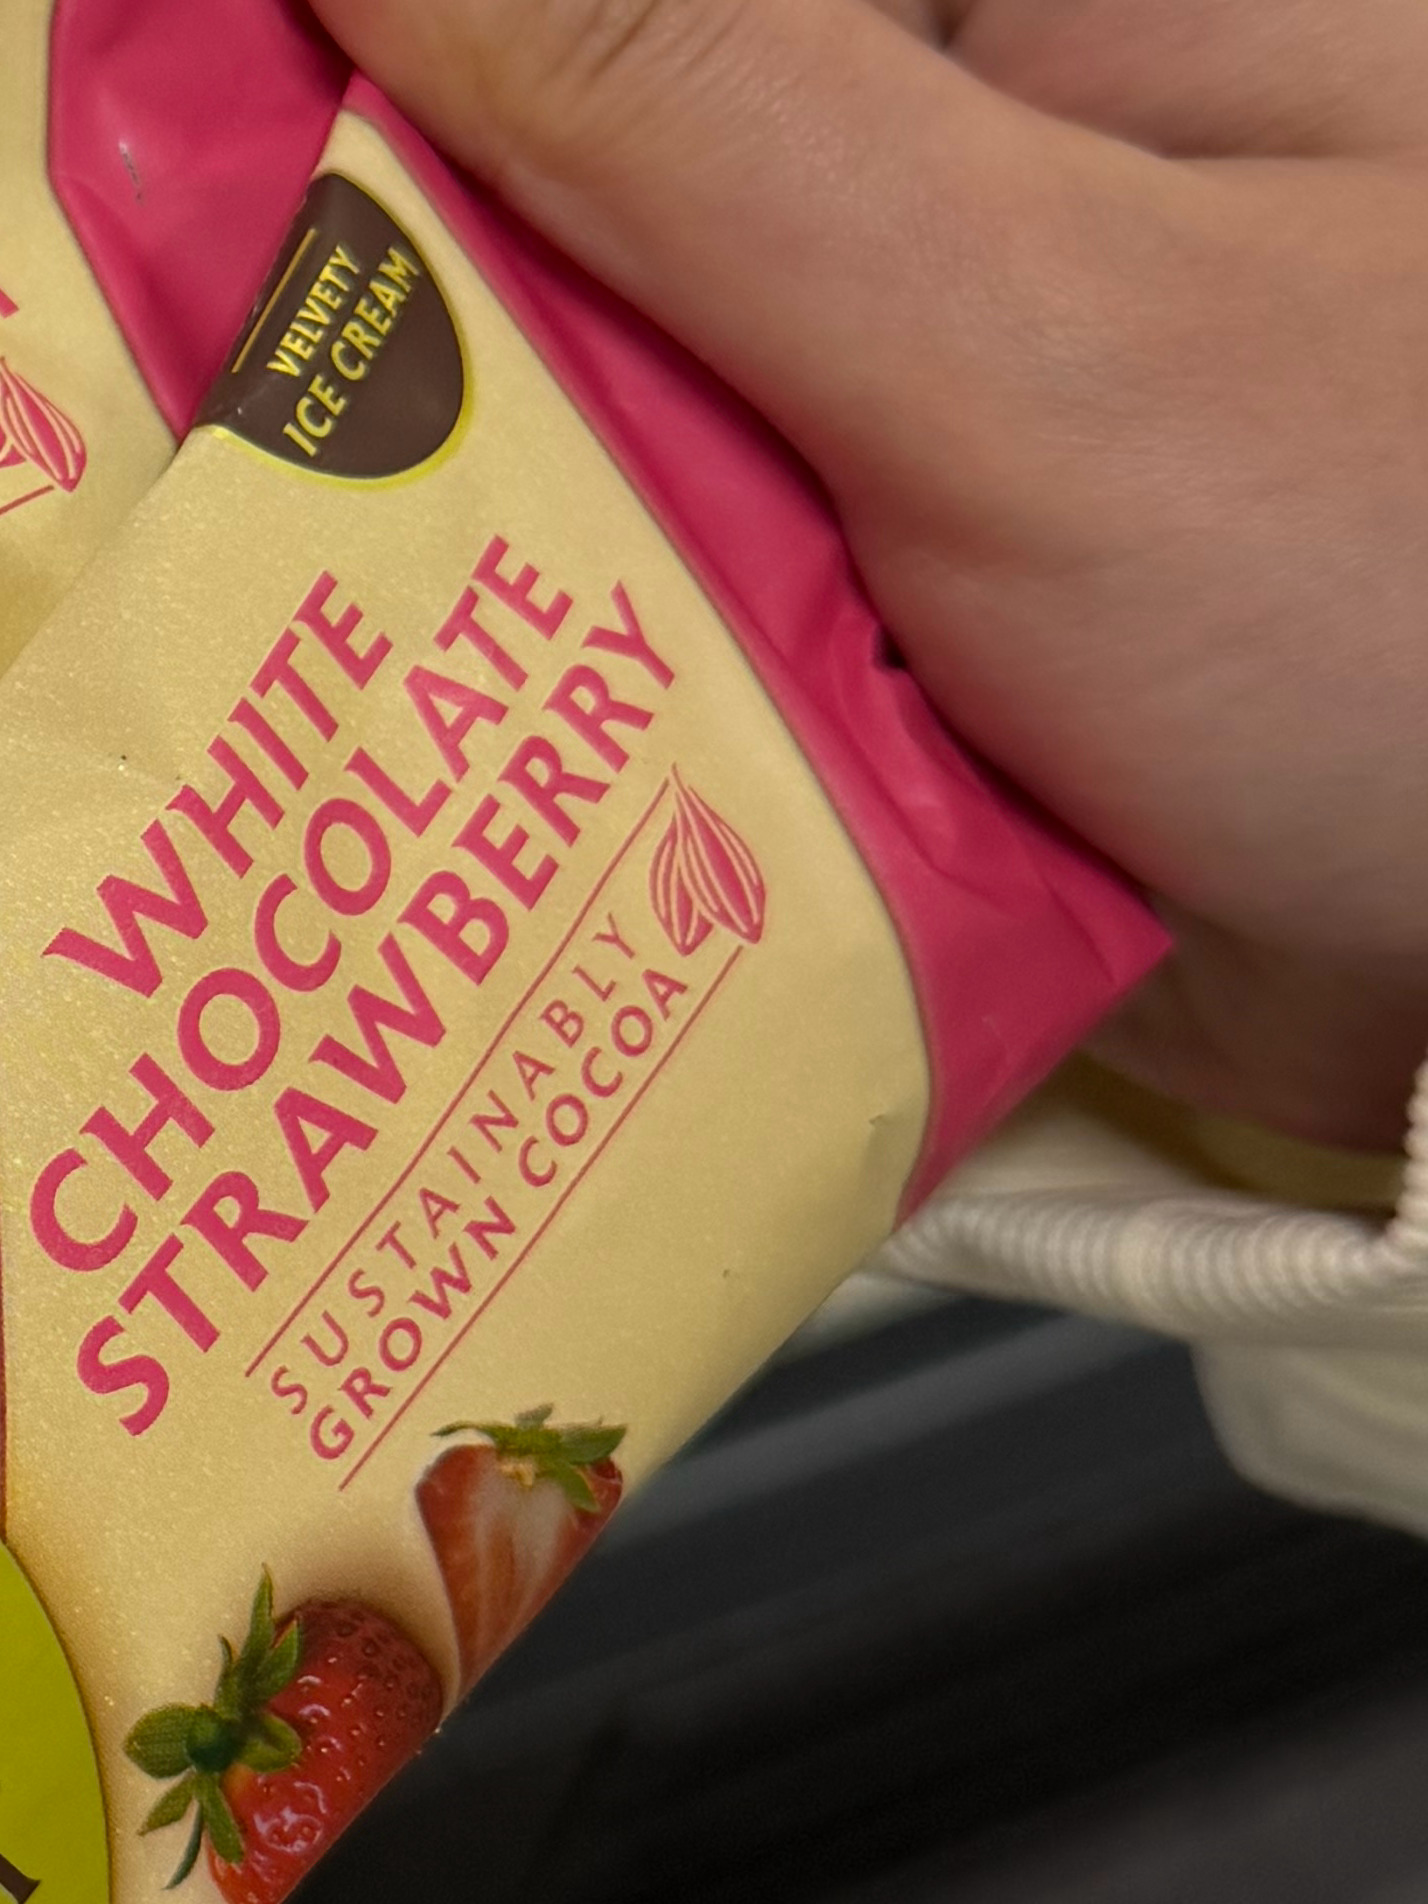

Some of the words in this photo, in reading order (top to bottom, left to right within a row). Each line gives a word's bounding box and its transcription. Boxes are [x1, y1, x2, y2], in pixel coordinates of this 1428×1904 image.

[266, 246, 360, 377] VELVETY
[283, 374, 347, 457] ICE
[331, 246, 420, 380] CREAM
[28, 534, 571, 1273] CHOCOLATE
[42, 570, 394, 1000] WHITE
[74, 581, 678, 1437] STRAWBERRY
[269, 913, 652, 1415] SUSTAINABLY
[309, 1208, 520, 1462] GROWN
[520, 966, 687, 1188] COCOA
